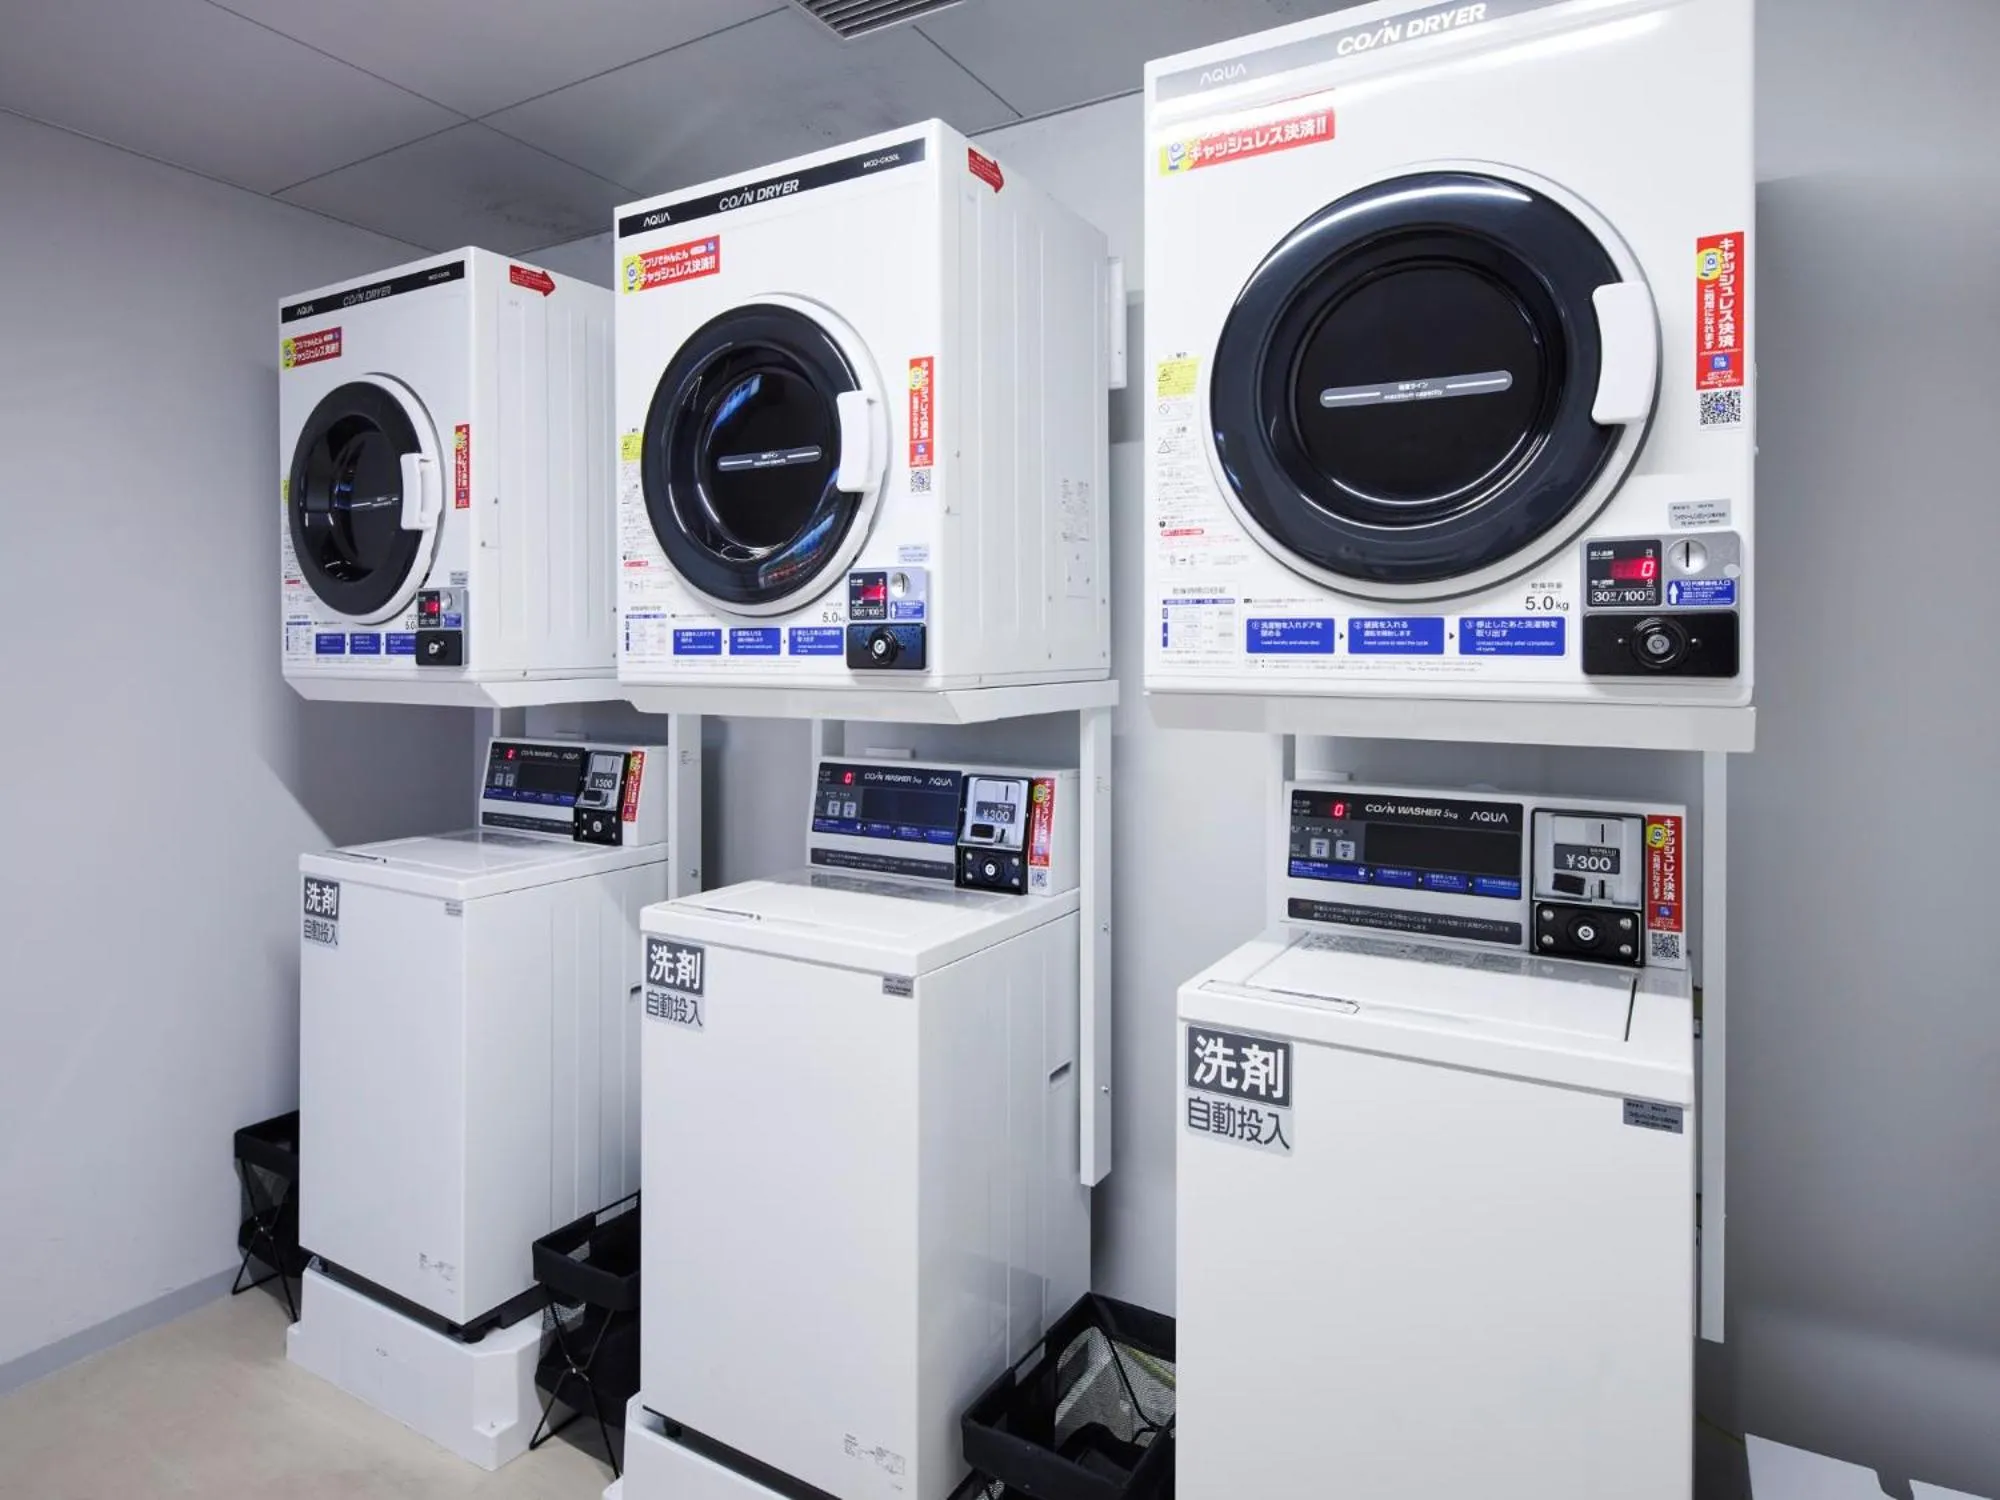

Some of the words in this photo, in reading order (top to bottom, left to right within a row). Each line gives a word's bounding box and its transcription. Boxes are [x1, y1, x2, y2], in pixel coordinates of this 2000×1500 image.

[1405, 3, 1487, 39] DRYER
[1199, 63, 1247, 86] AQUA
[756, 178, 800, 201] DRYER
[643, 212, 671, 228] AQUA
[1641, 560, 1656, 577] 0
[982, 808, 1011, 822] ¥300
[1334, 803, 1345, 817] 0
[1397, 806, 1442, 818] WASHER
[1469, 811, 1509, 824] AQUA
[1565, 853, 1612, 872] ¥300
[305, 881, 338, 916] 洗剤
[650, 943, 701, 990] 洗剤
[646, 989, 703, 1026] 自動投入
[1193, 1034, 1285, 1099] 洗剤
[1187, 1095, 1291, 1151] 自動投入
